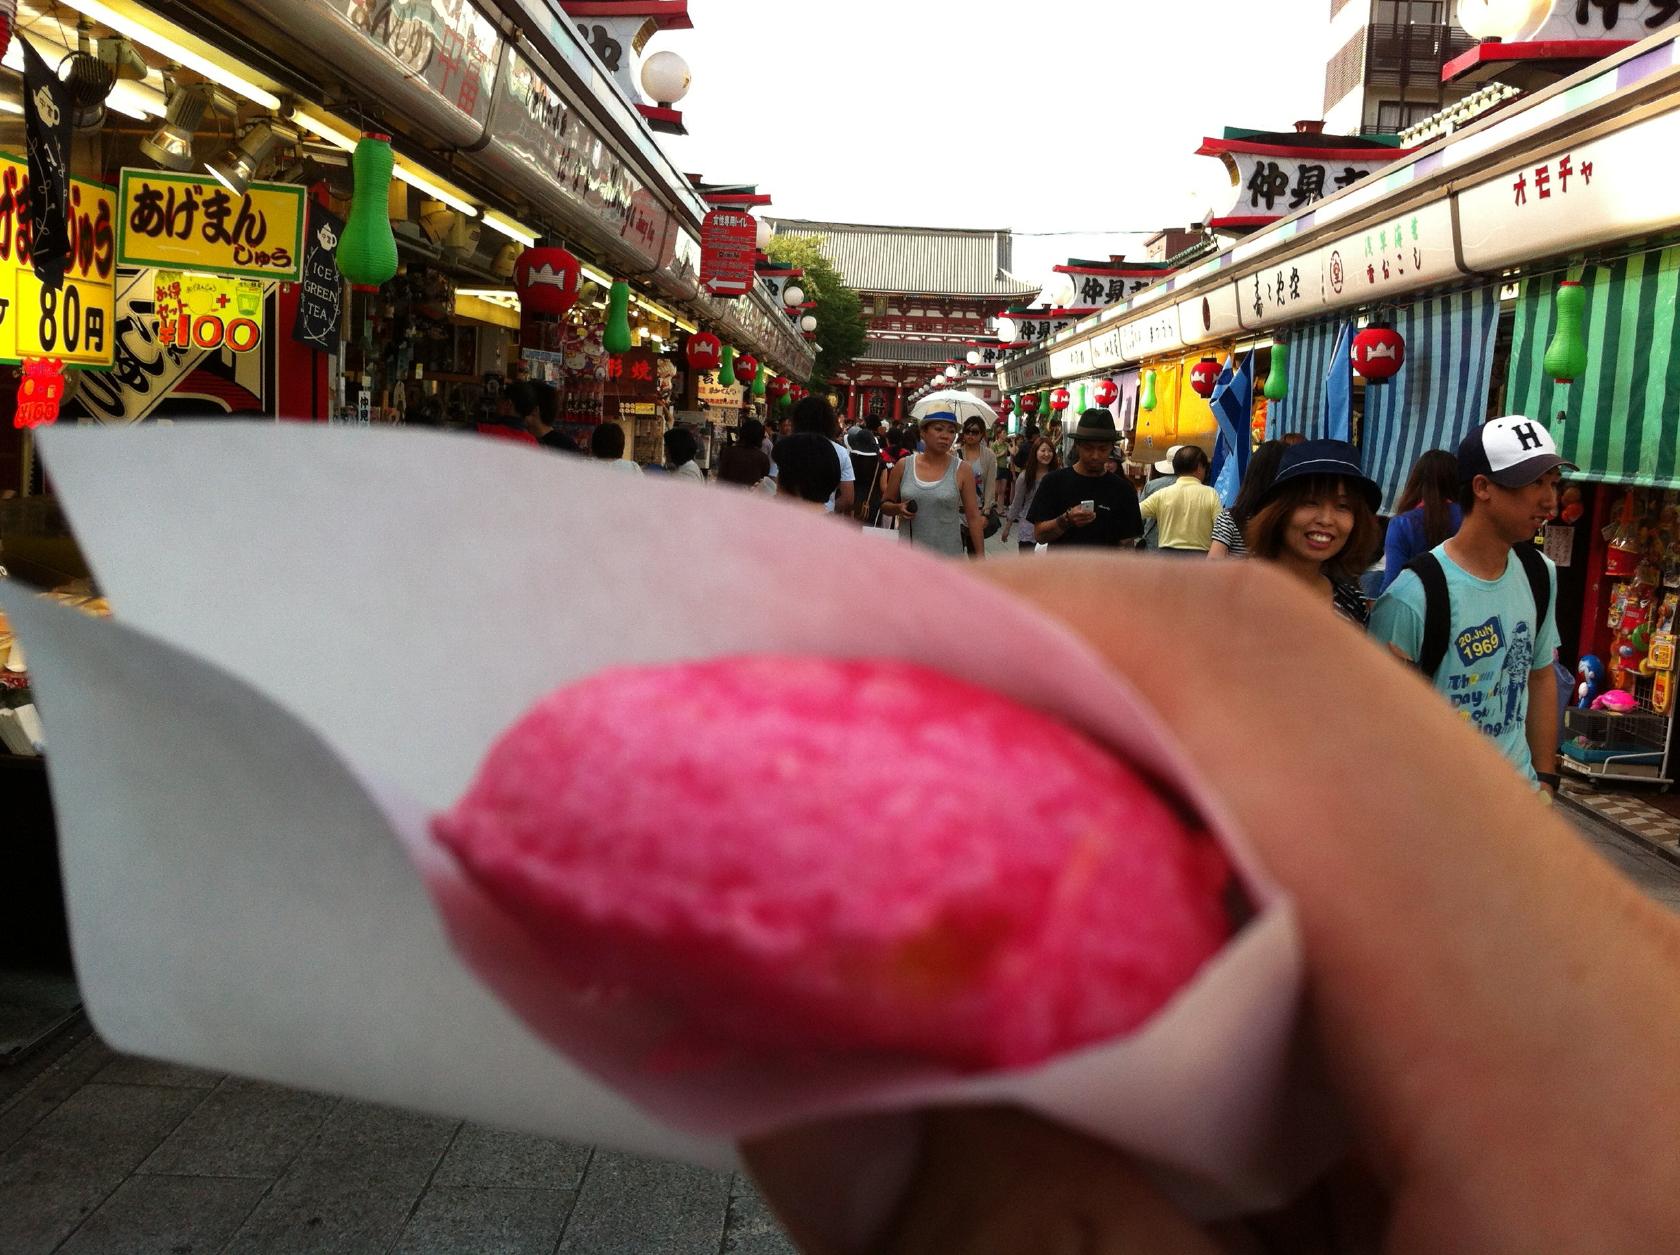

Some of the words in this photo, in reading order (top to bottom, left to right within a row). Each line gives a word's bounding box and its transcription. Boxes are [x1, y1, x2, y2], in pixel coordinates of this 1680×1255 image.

[1513, 154, 1593, 206] オモチャ
[130, 183, 267, 247] あげまん
[233, 243, 292, 268] じゅう
[313, 262, 333, 281] ICE
[304, 279, 338, 304] GREEN
[39, 283, 104, 353] 80円
[308, 302, 328, 321] TEA
[159, 314, 262, 353] ¥100
[1511, 422, 1543, 451] H
[1463, 633, 1499, 659] 1969
[1448, 673, 1479, 690] The
